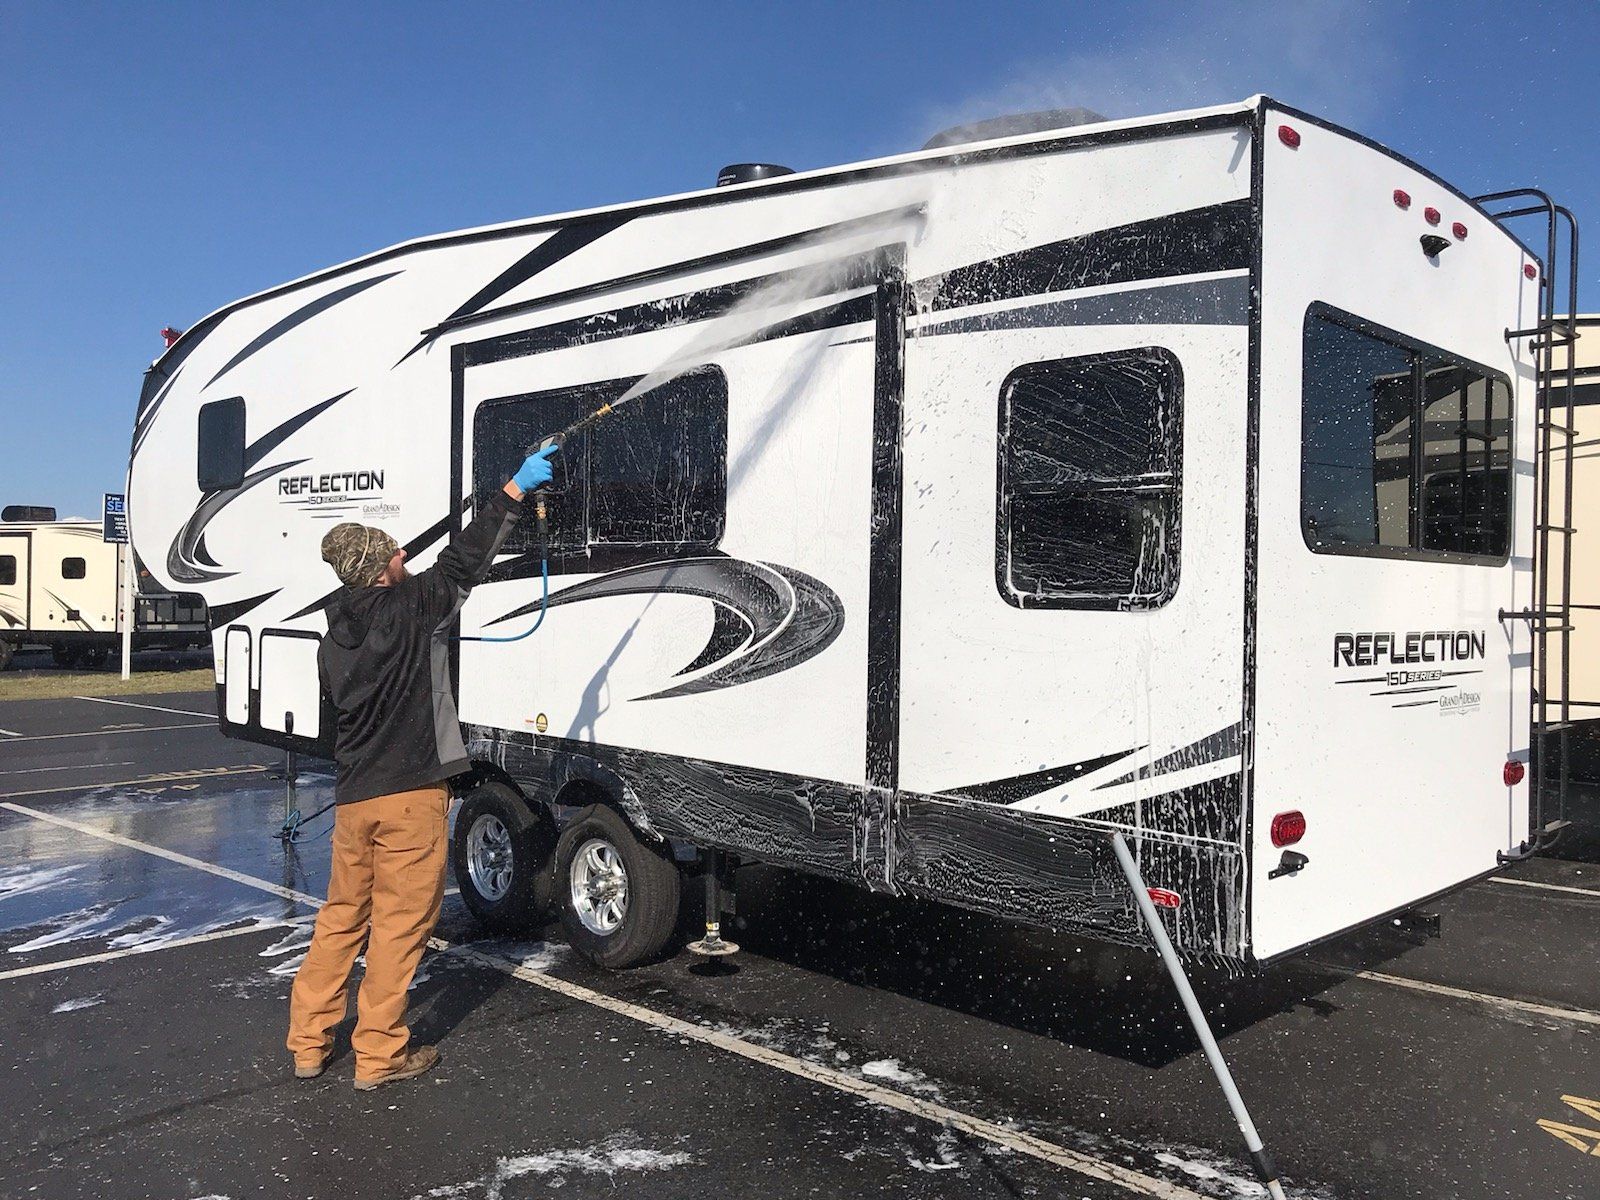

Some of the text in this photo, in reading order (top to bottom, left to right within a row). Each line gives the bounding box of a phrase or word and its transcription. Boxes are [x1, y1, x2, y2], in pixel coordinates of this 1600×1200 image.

[279, 469, 384, 495] REFLECTION
[107, 500, 125, 512] SE
[1334, 630, 1485, 668] REFLECTION
[1439, 692, 1481, 708] GRAND DESIGN
